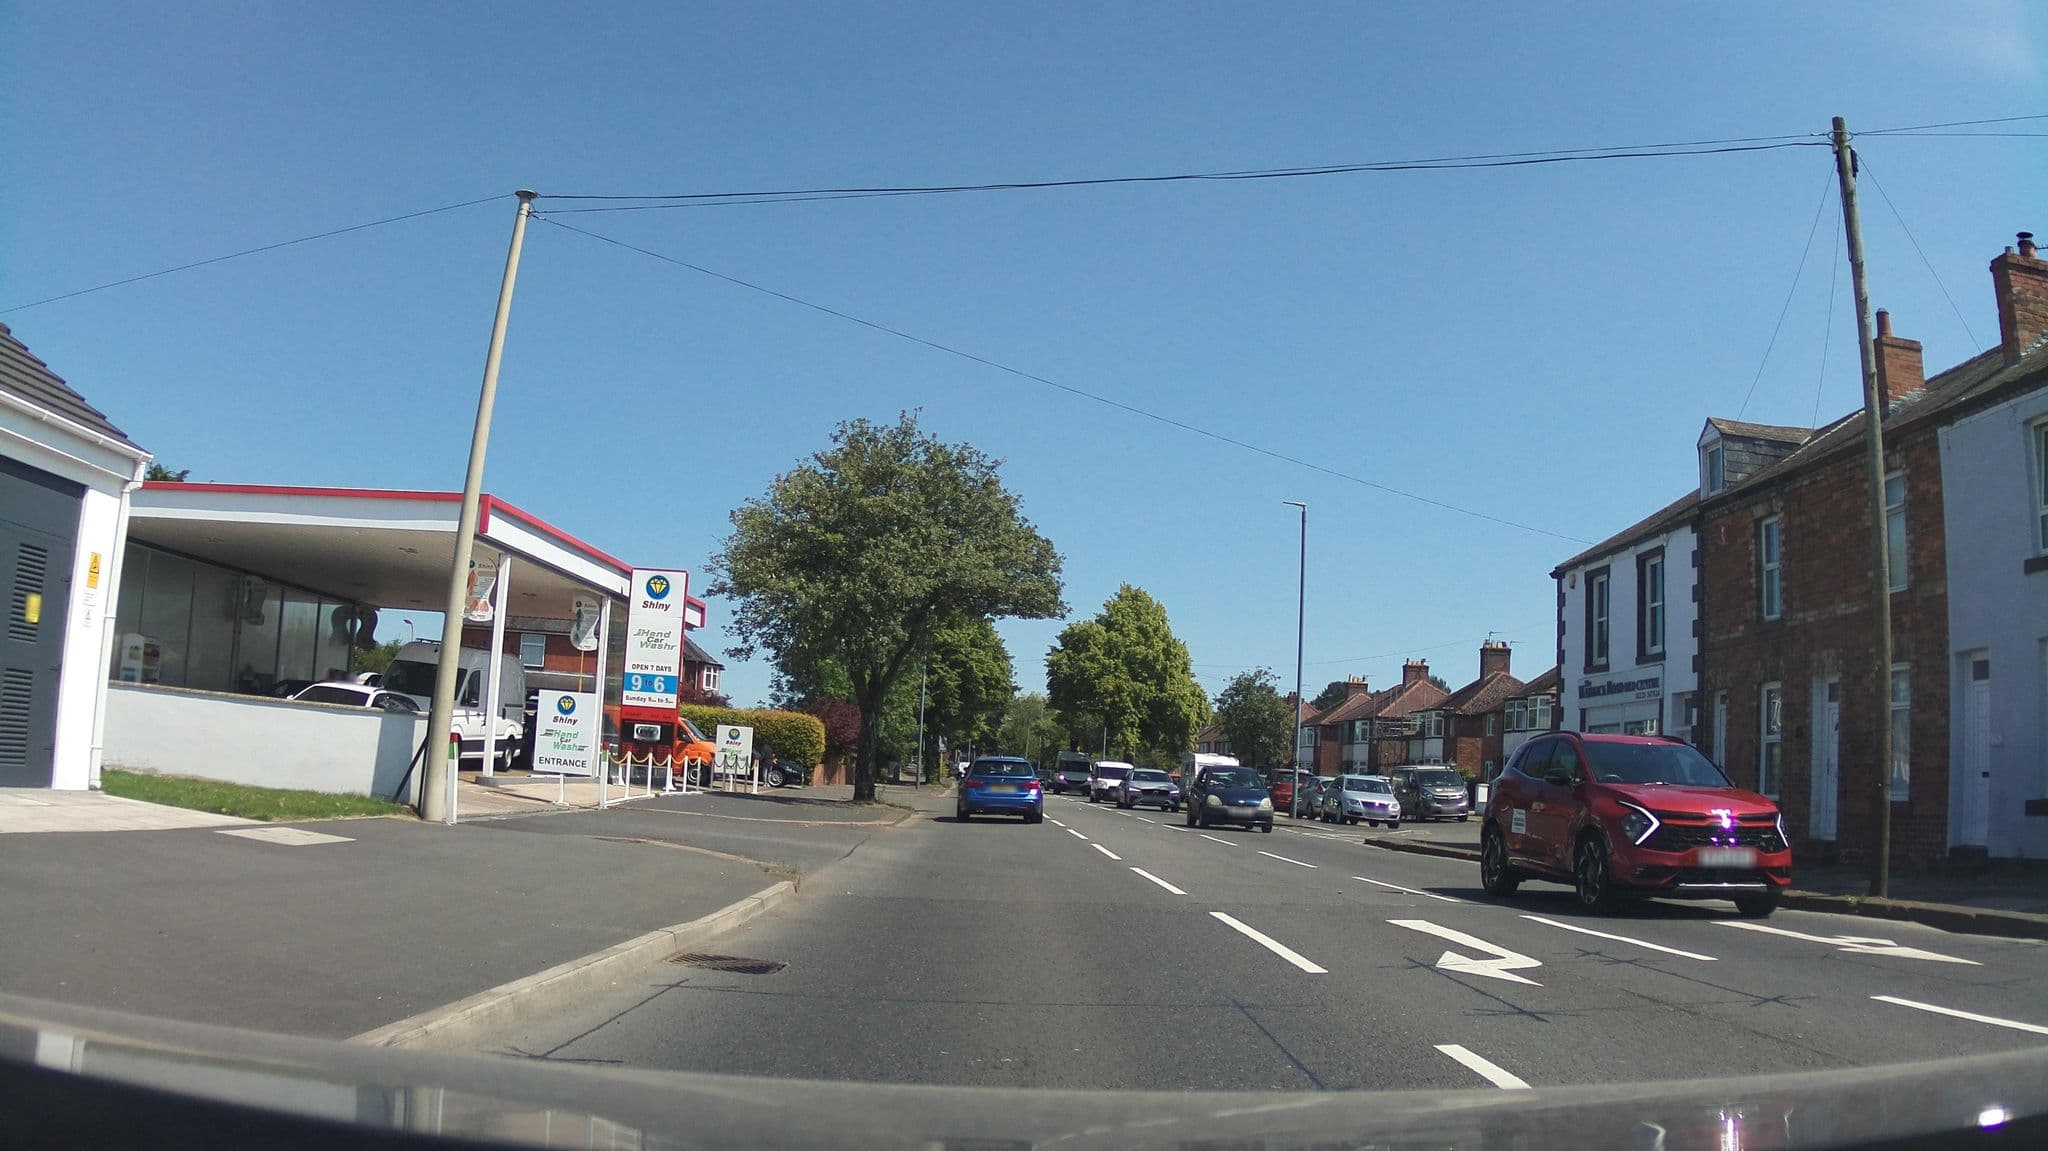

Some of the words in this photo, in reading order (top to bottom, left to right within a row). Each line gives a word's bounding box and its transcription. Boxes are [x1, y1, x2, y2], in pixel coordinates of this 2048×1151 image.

[642, 600, 671, 612] Shiny
[640, 629, 672, 638] Hand
[631, 663, 649, 671] OPEN
[631, 674, 642, 691] 9
[644, 679, 653, 687] to
[654, 676, 665, 693] 6
[625, 695, 646, 703] Sunday
[552, 716, 578, 725] Shiny
[553, 730, 579, 739] Hand
[552, 741, 578, 751] Wash
[539, 756, 588, 768] ENTRANCE
